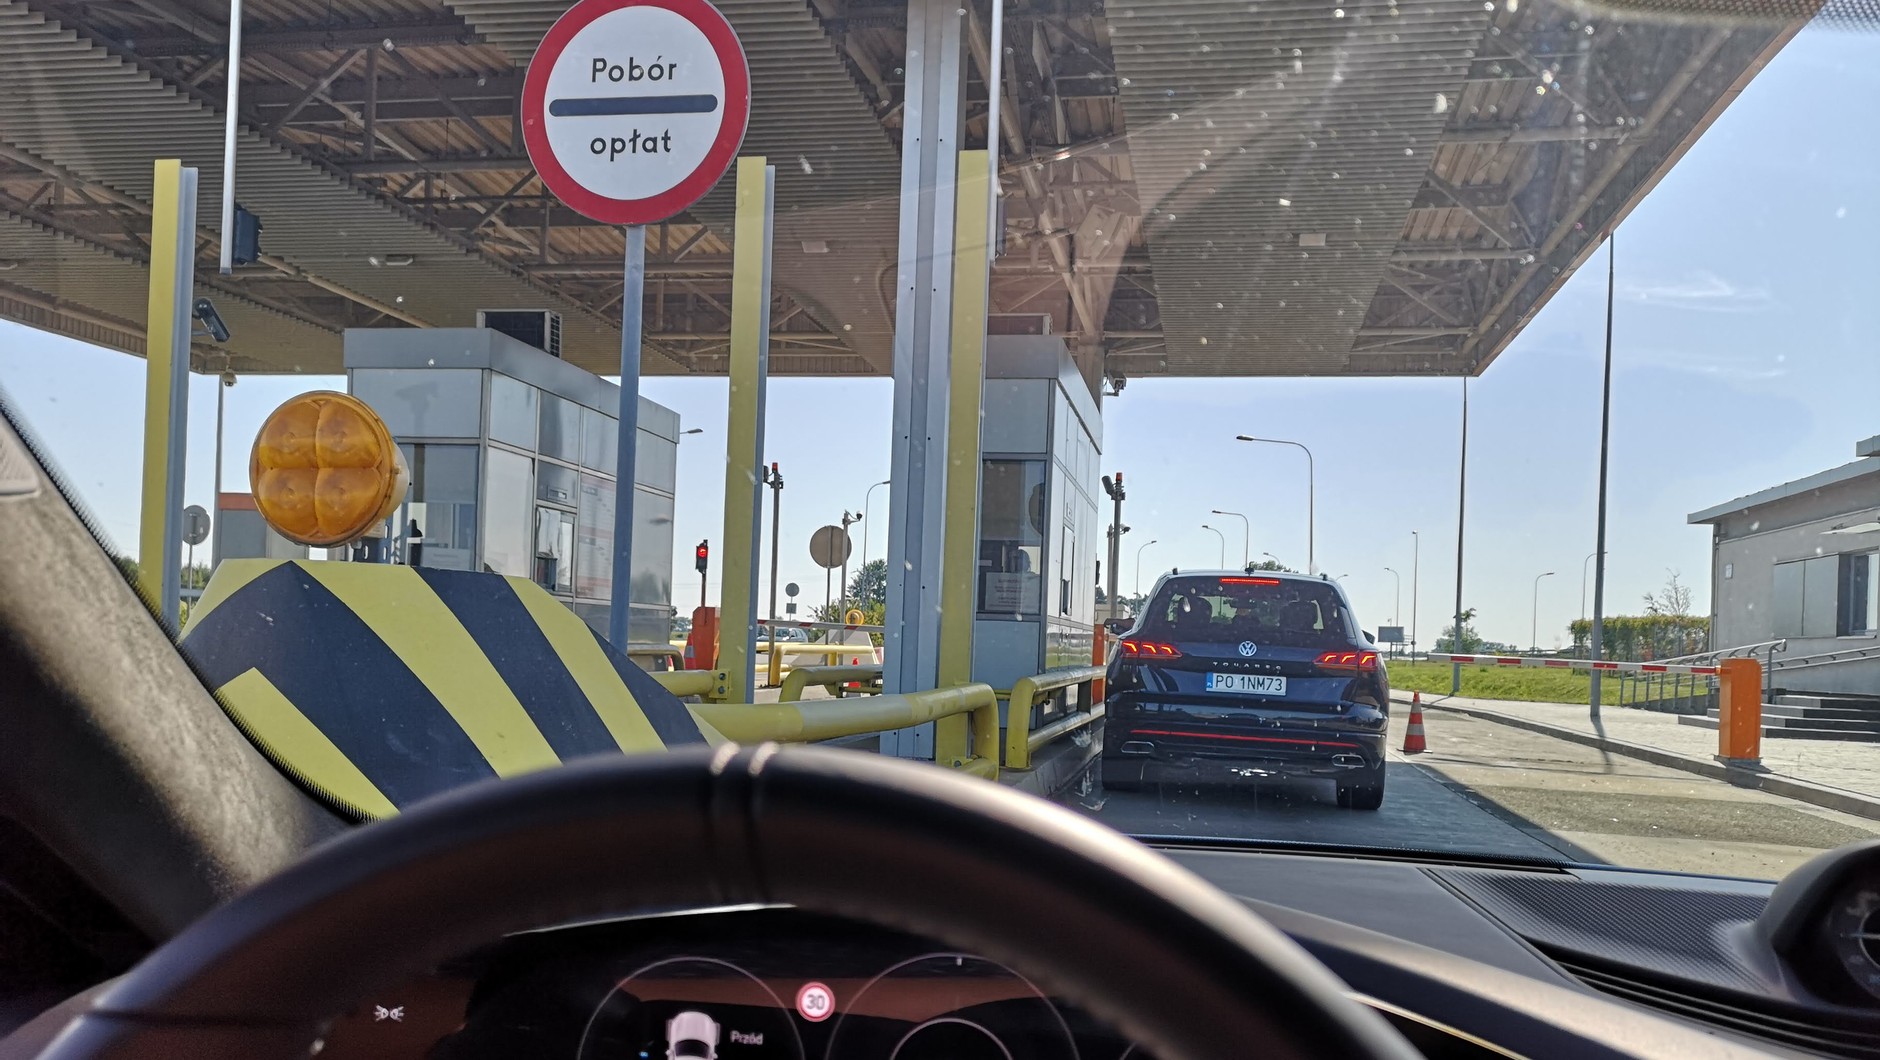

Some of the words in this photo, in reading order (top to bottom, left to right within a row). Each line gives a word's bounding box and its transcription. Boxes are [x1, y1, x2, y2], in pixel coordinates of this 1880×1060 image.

[592, 56, 677, 82] Pobór
[590, 129, 671, 161] opłat
[1216, 675, 1234, 688] PO
[1240, 676, 1283, 691] 1NM73
[806, 994, 825, 1010] 30
[730, 1030, 763, 1045] Przód
